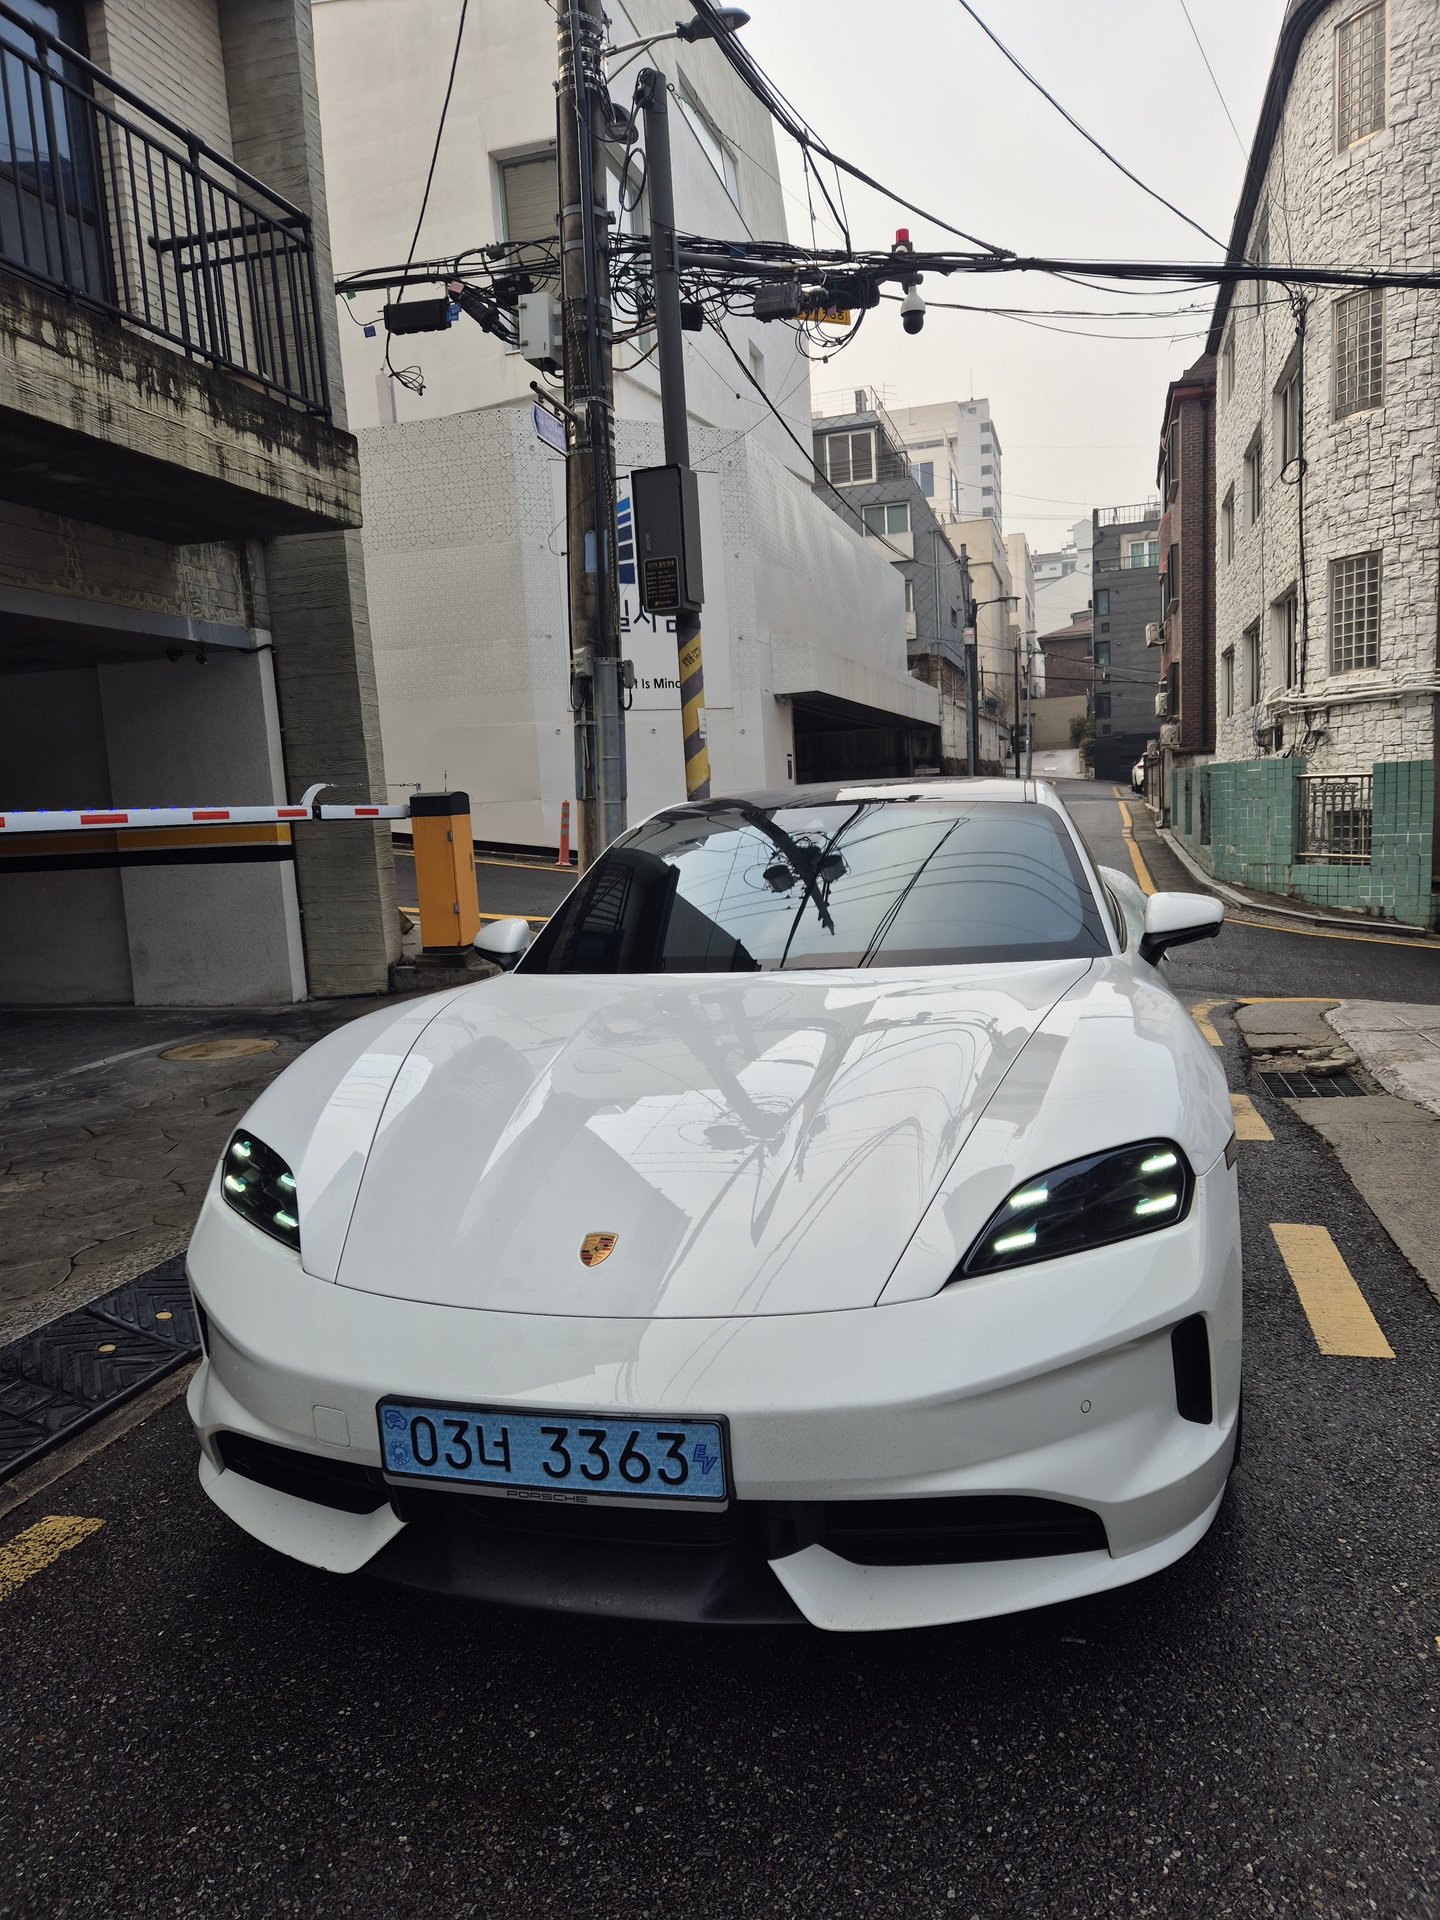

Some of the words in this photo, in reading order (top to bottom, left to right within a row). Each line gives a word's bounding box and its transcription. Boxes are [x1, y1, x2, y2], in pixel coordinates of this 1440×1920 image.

[641, 678, 651, 689] Is
[410, 1415, 511, 1472] 03너
[540, 1426, 689, 1486] 3363
[693, 1444, 718, 1475] EV
[506, 1490, 588, 1504] PORSCHE
